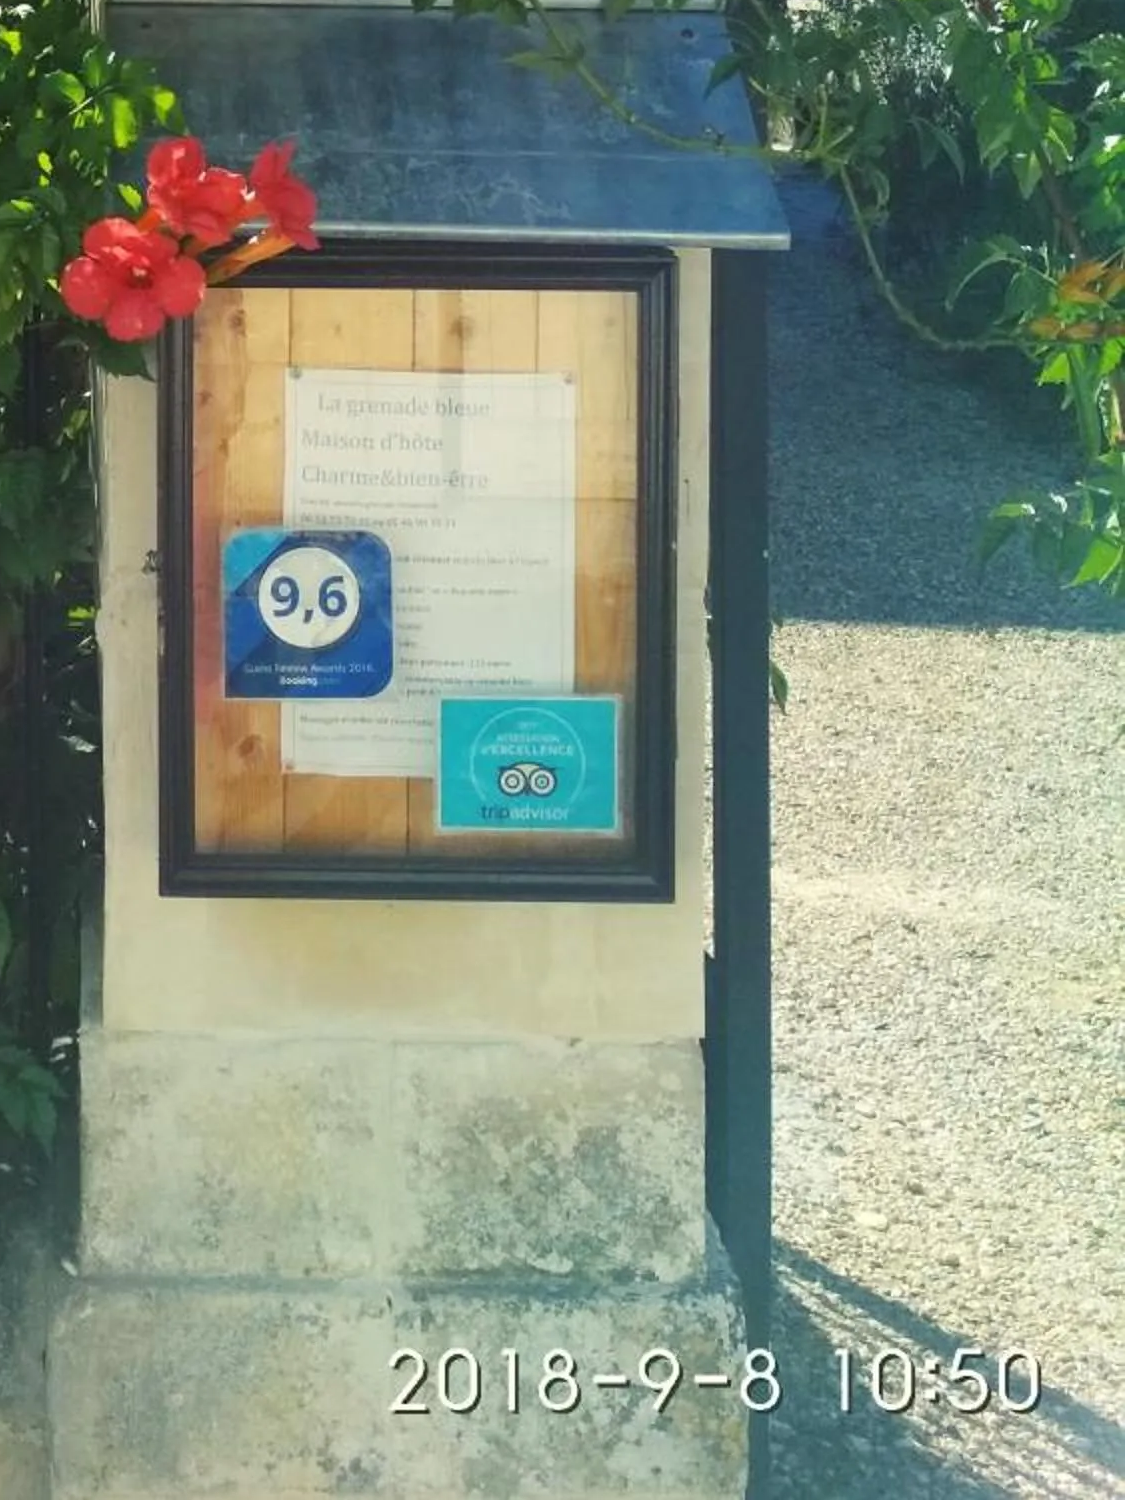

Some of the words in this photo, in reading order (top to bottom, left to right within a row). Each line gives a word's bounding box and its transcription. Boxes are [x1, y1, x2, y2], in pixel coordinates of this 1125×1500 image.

[318, 393, 341, 412] La
[346, 395, 430, 417] grenade
[435, 395, 490, 416] bleue
[301, 428, 376, 451] Maison
[270, 575, 348, 624] 9,6
[480, 802, 570, 822] tripadvisor
